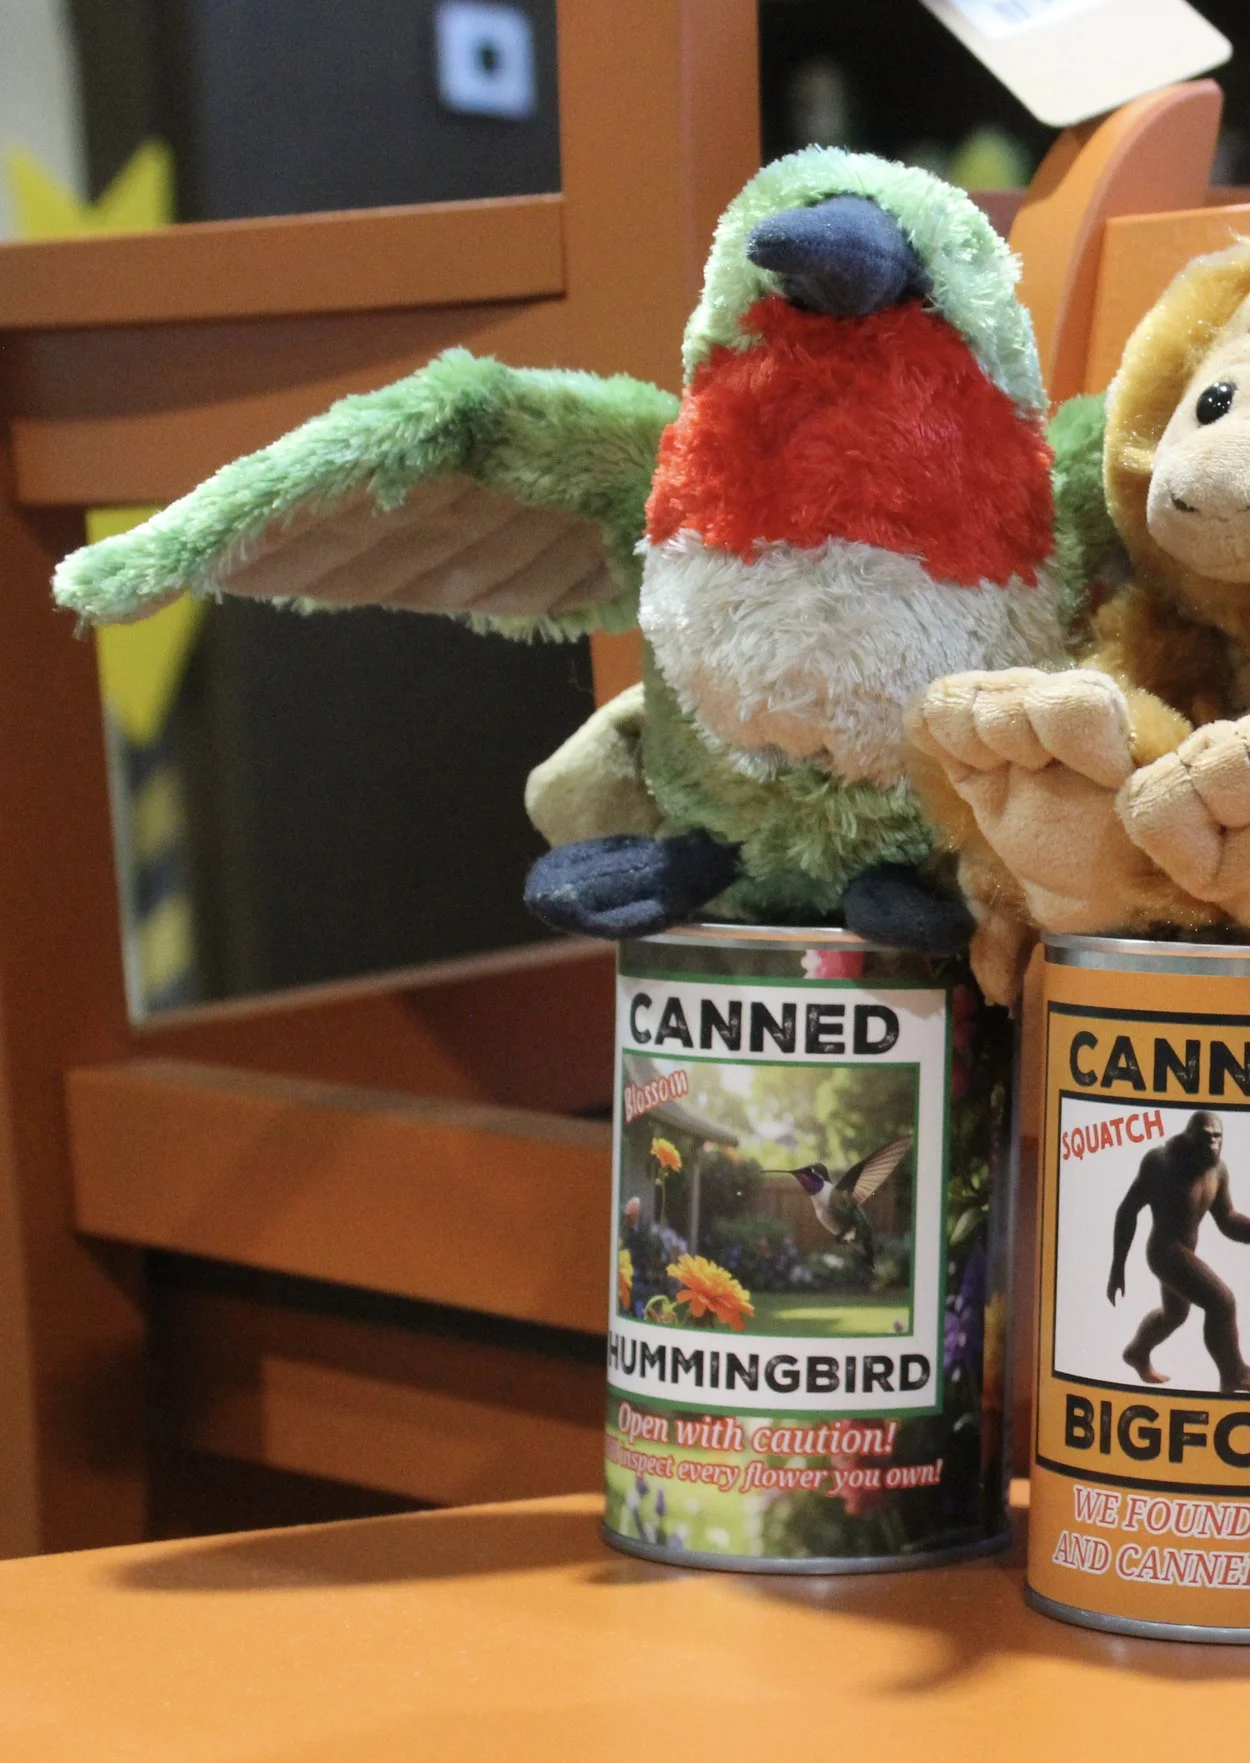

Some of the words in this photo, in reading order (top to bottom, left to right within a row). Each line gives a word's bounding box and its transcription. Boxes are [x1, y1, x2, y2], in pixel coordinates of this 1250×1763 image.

[629, 991, 900, 1056] CANNED
[623, 1069, 689, 1124] Blossom
[1061, 1109, 1165, 1160] SQUATCH
[606, 1329, 932, 1394] HUMMINGBIRD
[618, 1400, 669, 1446] Open
[676, 1416, 744, 1451] with
[751, 1420, 897, 1455] caution!
[677, 1460, 740, 1492] every
[739, 1460, 829, 1493] flower
[828, 1469, 882, 1496] you
[886, 1458, 944, 1487] own!
[1073, 1485, 1120, 1525] WE
[1052, 1532, 1111, 1573] AND
